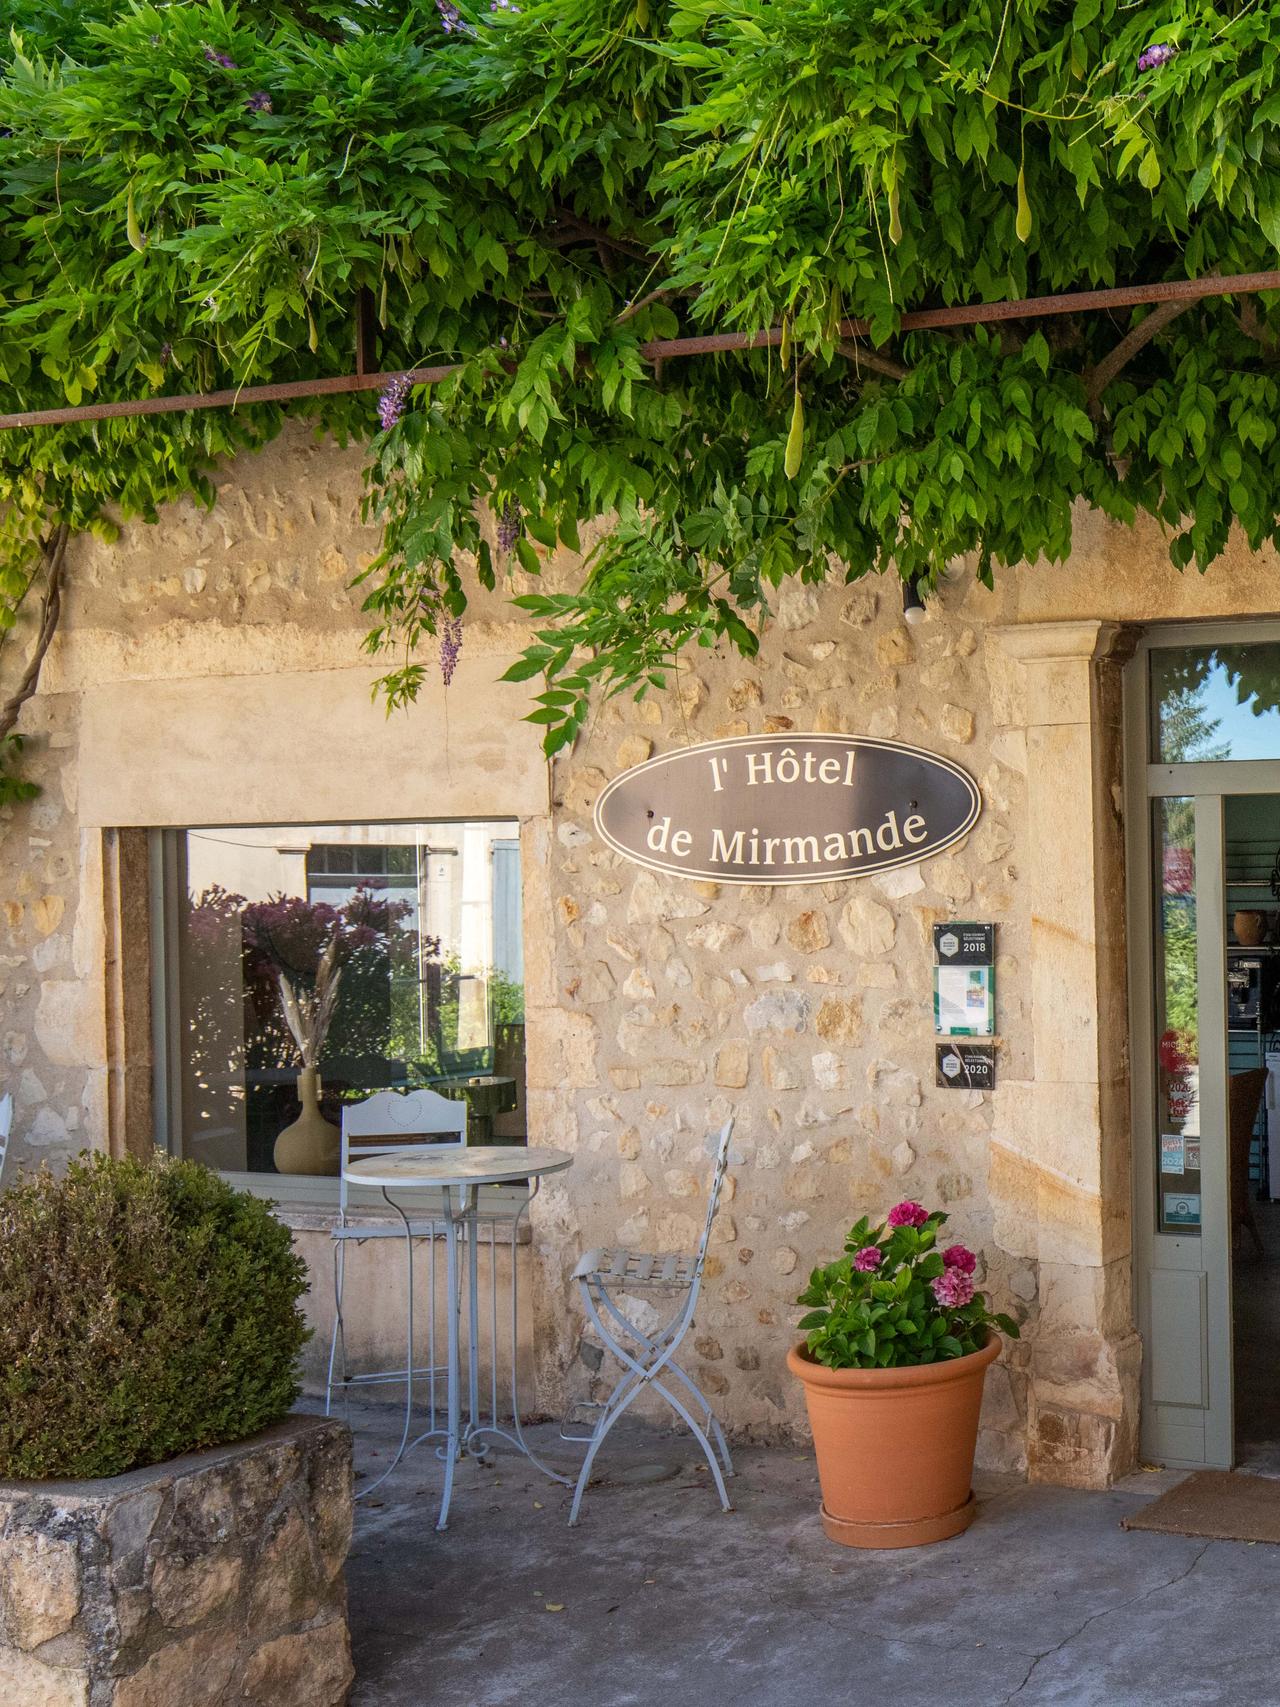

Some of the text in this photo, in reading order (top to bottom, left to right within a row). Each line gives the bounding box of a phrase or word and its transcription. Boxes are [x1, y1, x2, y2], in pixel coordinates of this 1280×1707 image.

[708, 747, 857, 792] l' Hôtel
[646, 810, 929, 866] de Mirmande
[963, 943, 986, 952] 2018
[964, 1064, 988, 1074] 2020
